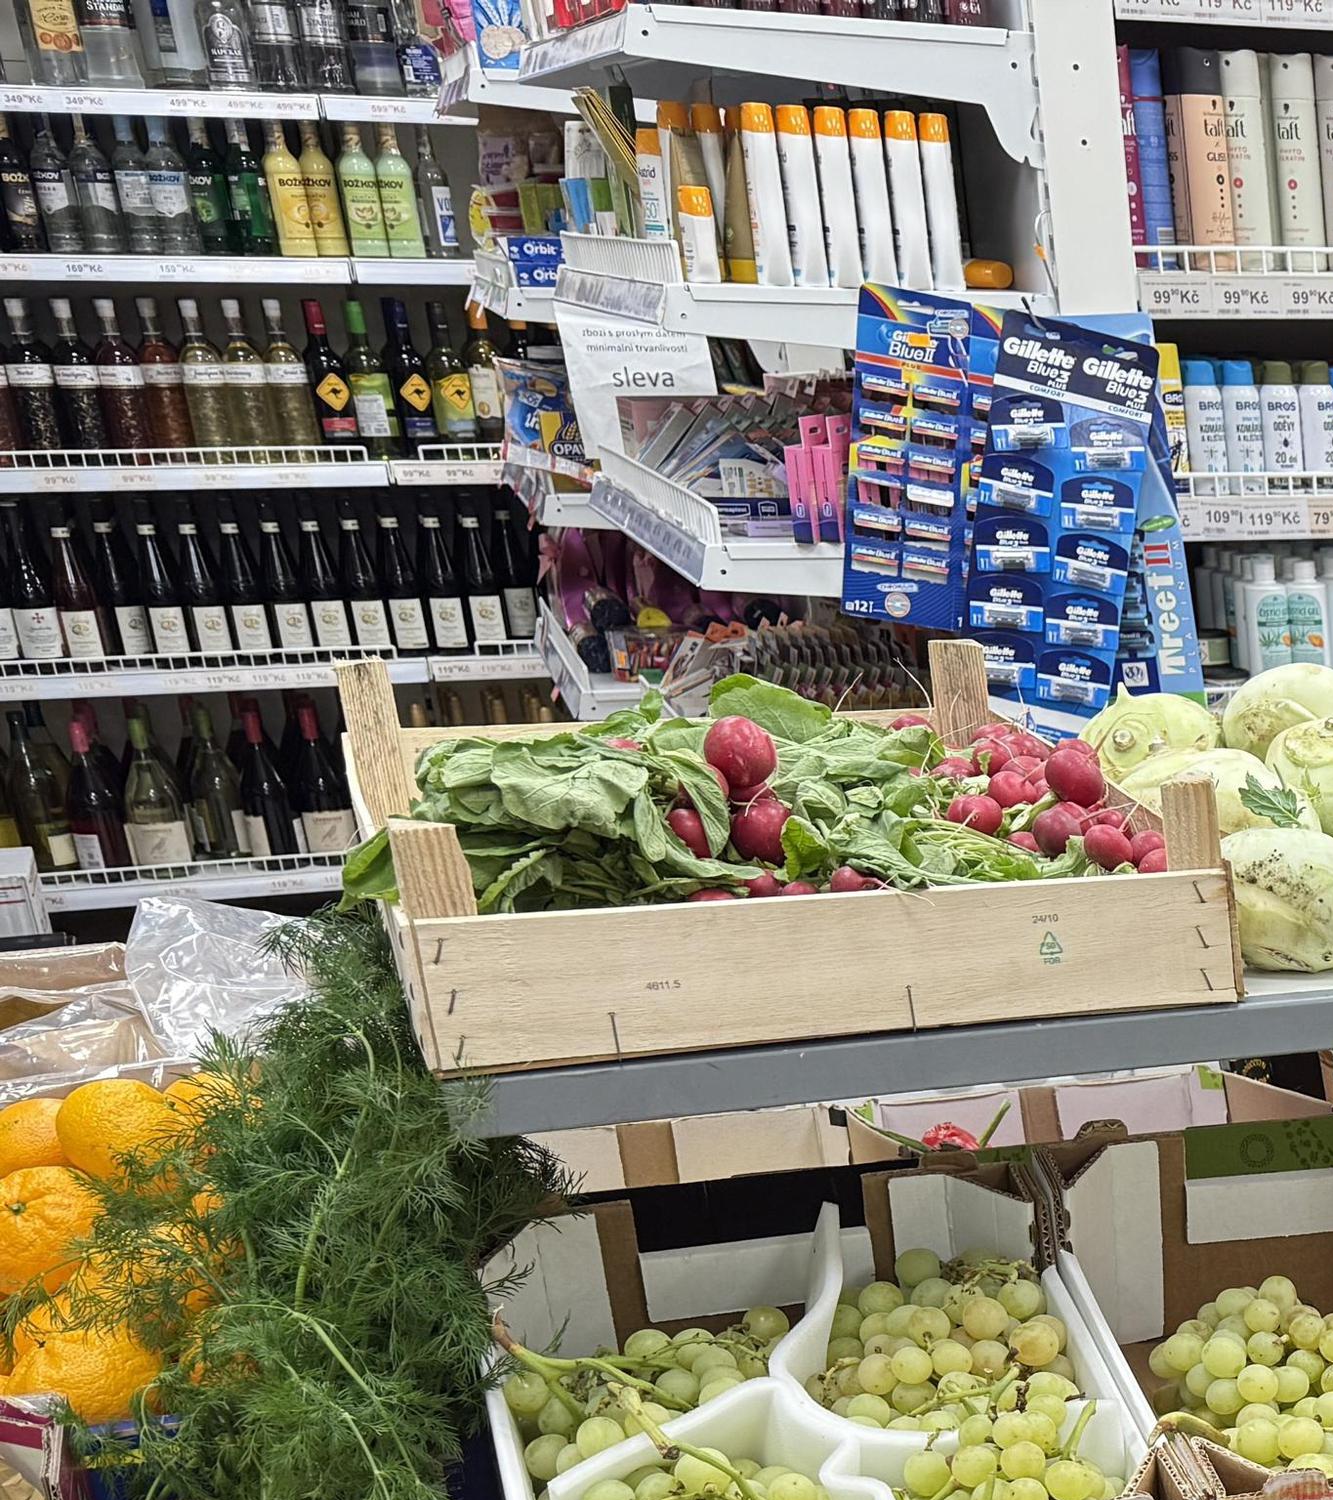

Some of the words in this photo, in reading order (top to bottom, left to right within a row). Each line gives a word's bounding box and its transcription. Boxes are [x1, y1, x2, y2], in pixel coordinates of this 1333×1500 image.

[1277, 120, 1301, 140] taft
[523, 243, 557, 255] Orbit
[533, 270, 556, 282] Orb
[1003, 337, 1075, 370] Gillette
[612, 366, 675, 388] sleva
[1082, 357, 1153, 390] Gillette
[1030, 385, 1065, 398] COMFORT
[1048, 380, 1067, 390] PLUS
[1108, 404, 1143, 418] COMFORT
[1126, 400, 1145, 410] PLUS
[1268, 401, 1296, 411] BROS
[553, 442, 584, 456] OPAV
[1275, 452, 1287, 463] 20
[996, 530, 1029, 541] Gillette
[1076, 546, 1109, 561] Gillette
[990, 588, 1023, 600] Gillette
[1066, 605, 1099, 618] Gillette
[1058, 662, 1092, 676] Gillette
